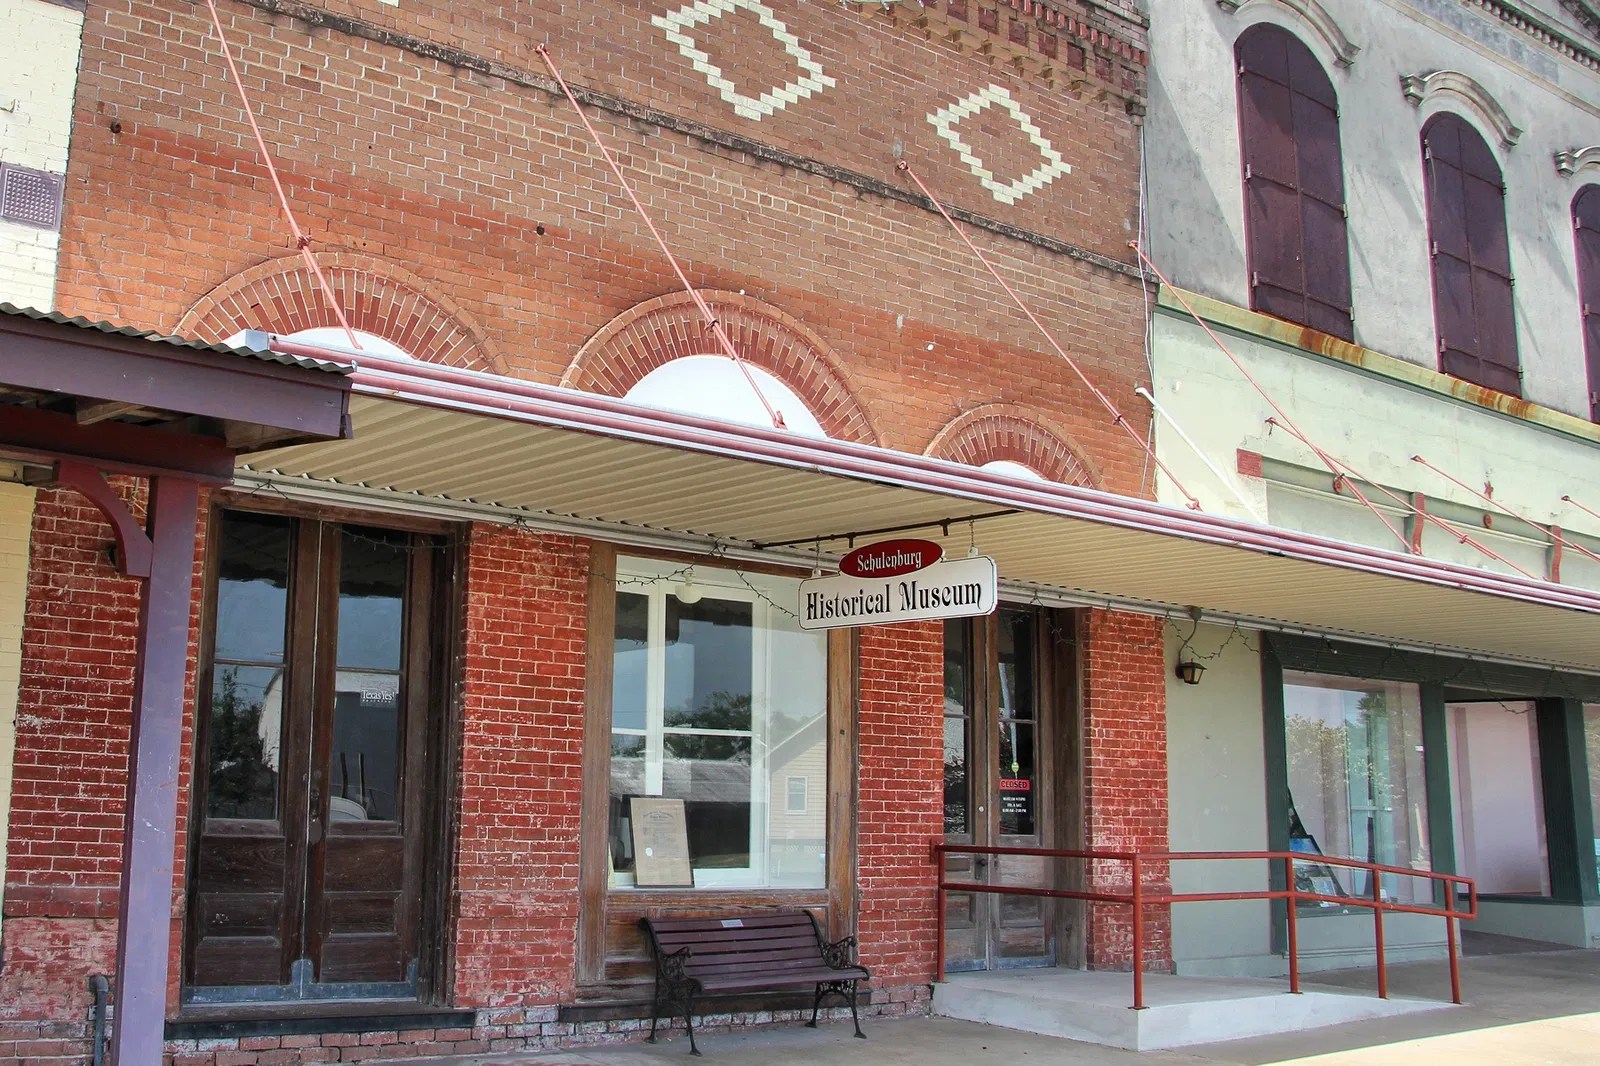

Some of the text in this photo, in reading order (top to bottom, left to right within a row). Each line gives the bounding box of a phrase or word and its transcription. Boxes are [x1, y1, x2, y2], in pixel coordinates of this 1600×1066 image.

[857, 550, 922, 572] Schulenburg
[806, 580, 981, 621] Historical Museum
[1001, 780, 1027, 788] CLOSED
